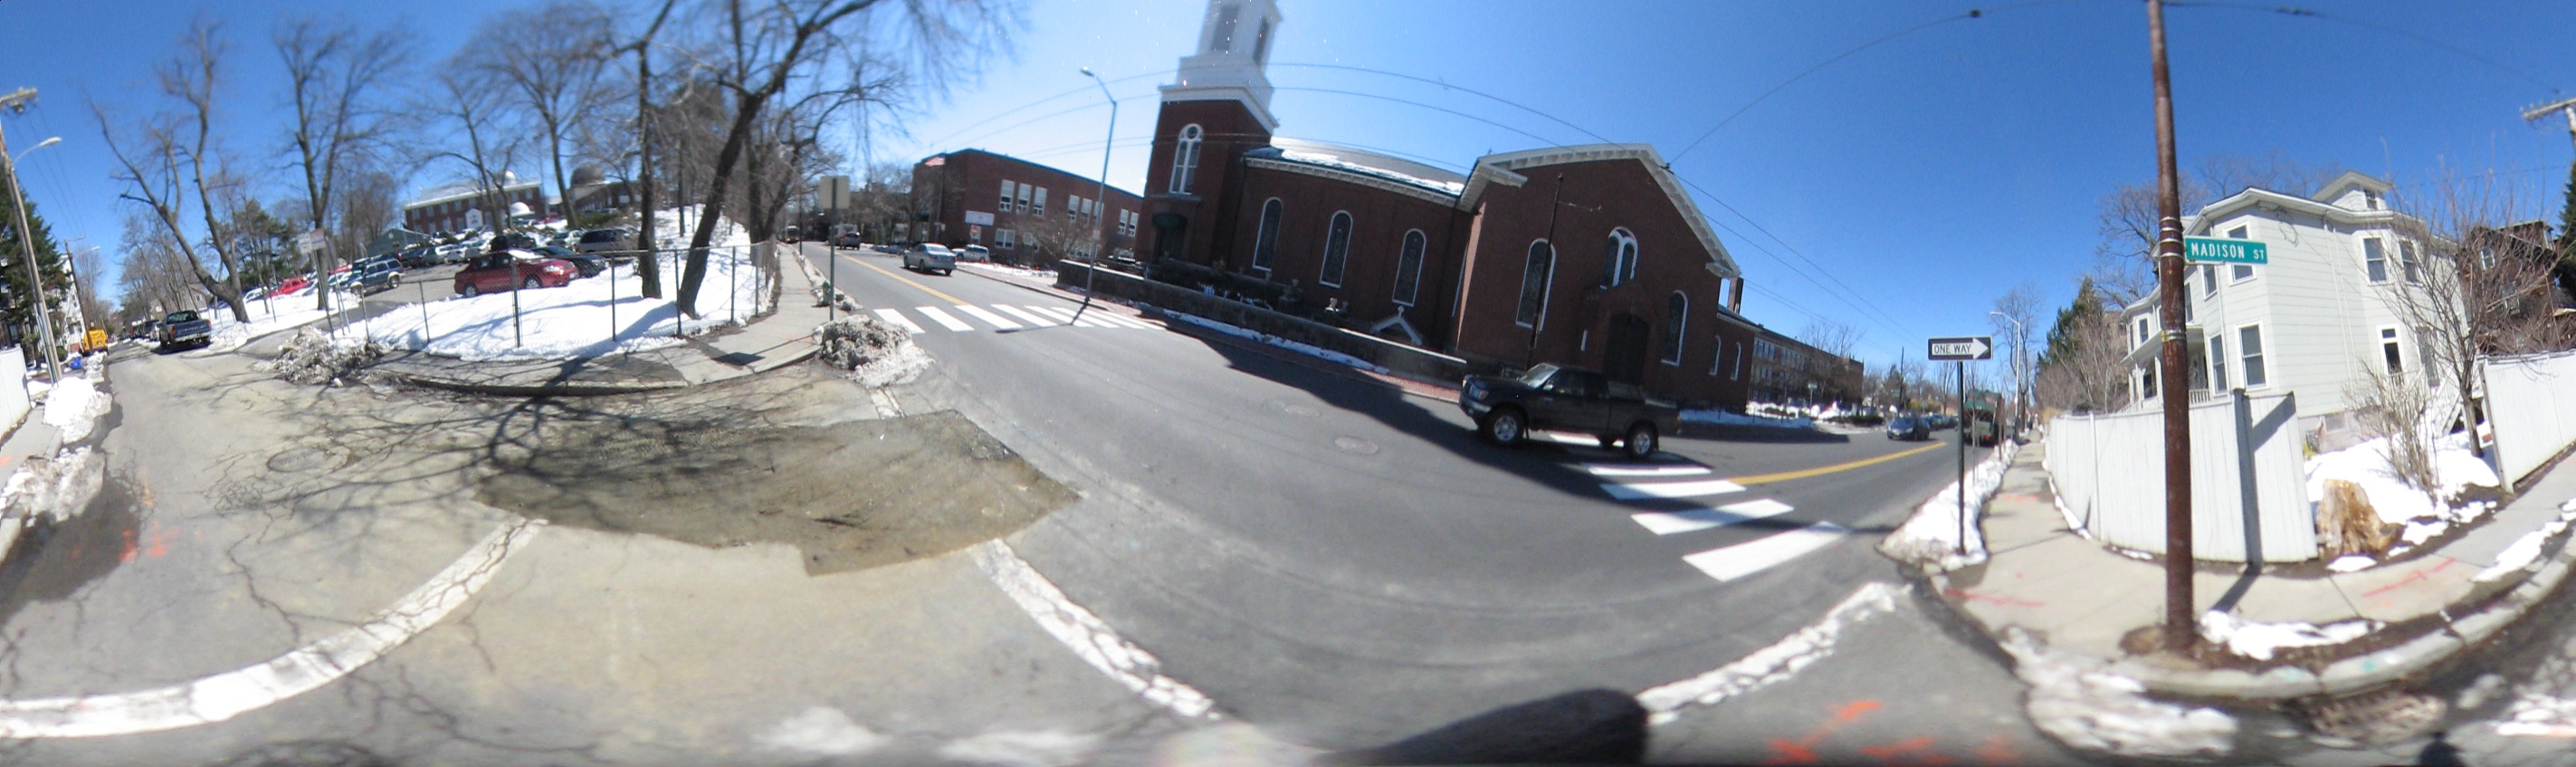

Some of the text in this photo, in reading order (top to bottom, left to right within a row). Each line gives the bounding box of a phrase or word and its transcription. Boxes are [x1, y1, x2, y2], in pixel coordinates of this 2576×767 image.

[2191, 243, 2265, 260] MADISON ST
[1934, 344, 1971, 354] ONE WAY
